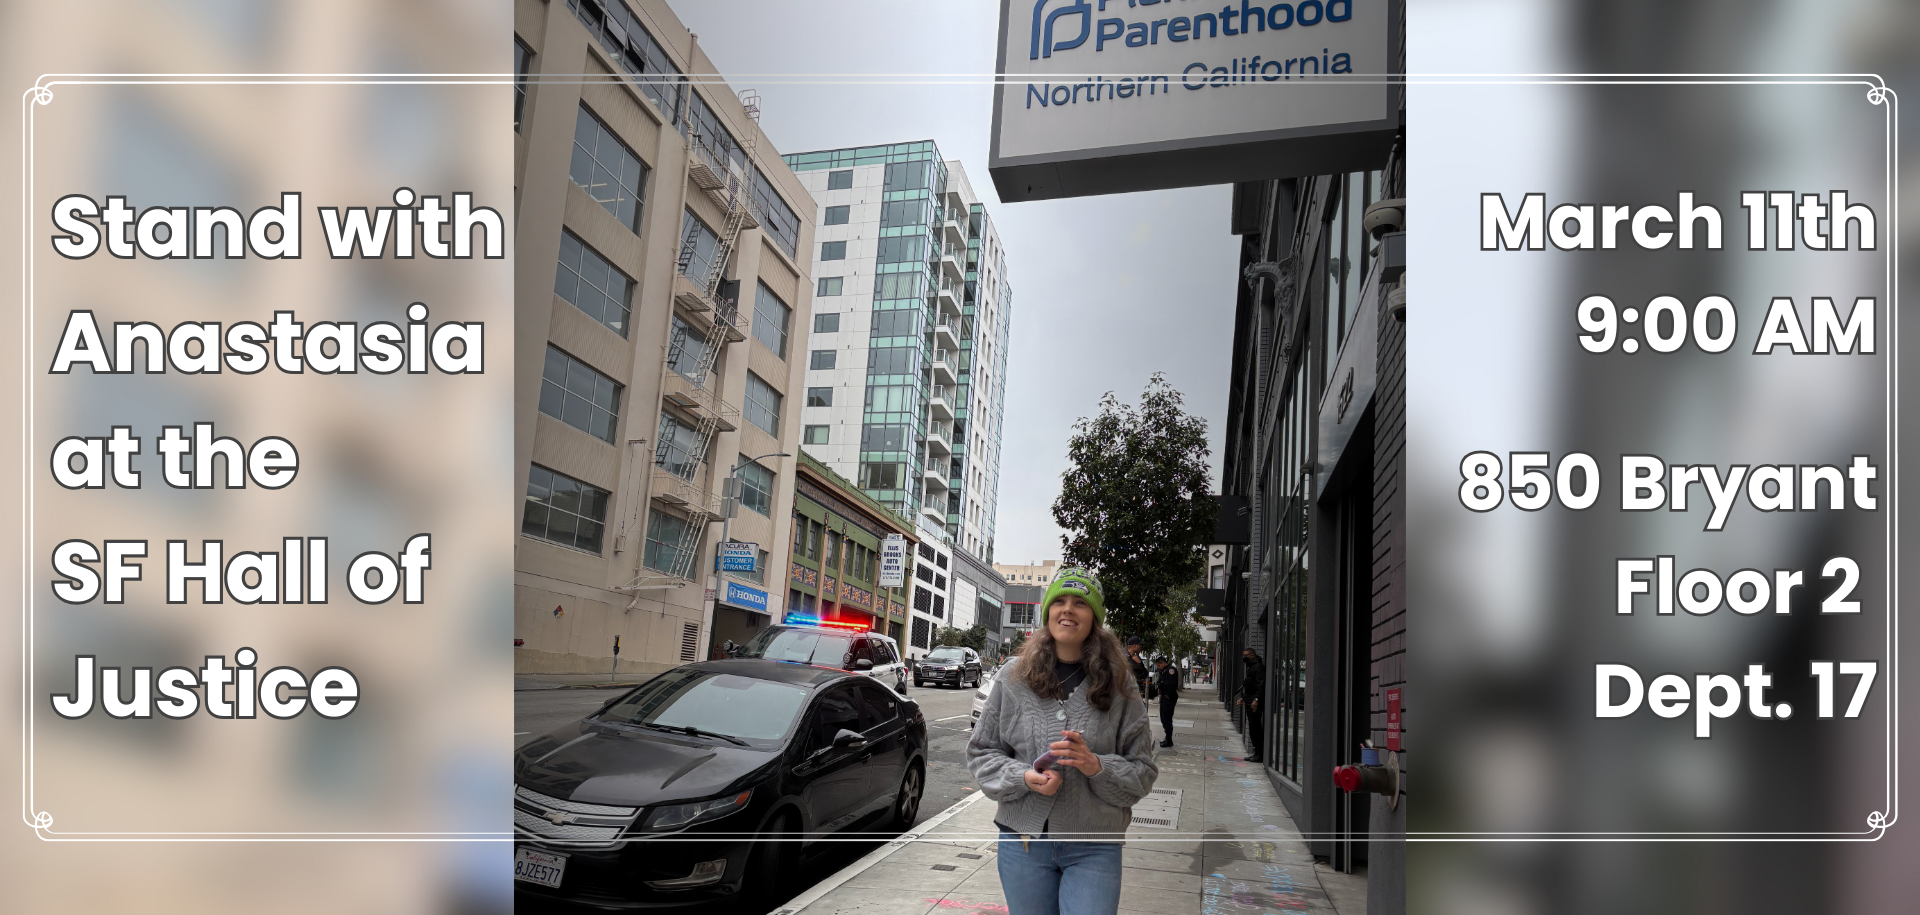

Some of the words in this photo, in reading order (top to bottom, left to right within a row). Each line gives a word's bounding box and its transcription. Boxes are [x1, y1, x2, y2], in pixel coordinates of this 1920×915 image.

[1096, 0, 1353, 52] Parenthood
[1026, 75, 1169, 109] Northern
[1181, 48, 1353, 91] California
[718, 563, 752, 572] NTRANCE
[736, 590, 766, 605] HONDA
[526, 853, 555, 865] California
[514, 860, 561, 884] 8JZE577
